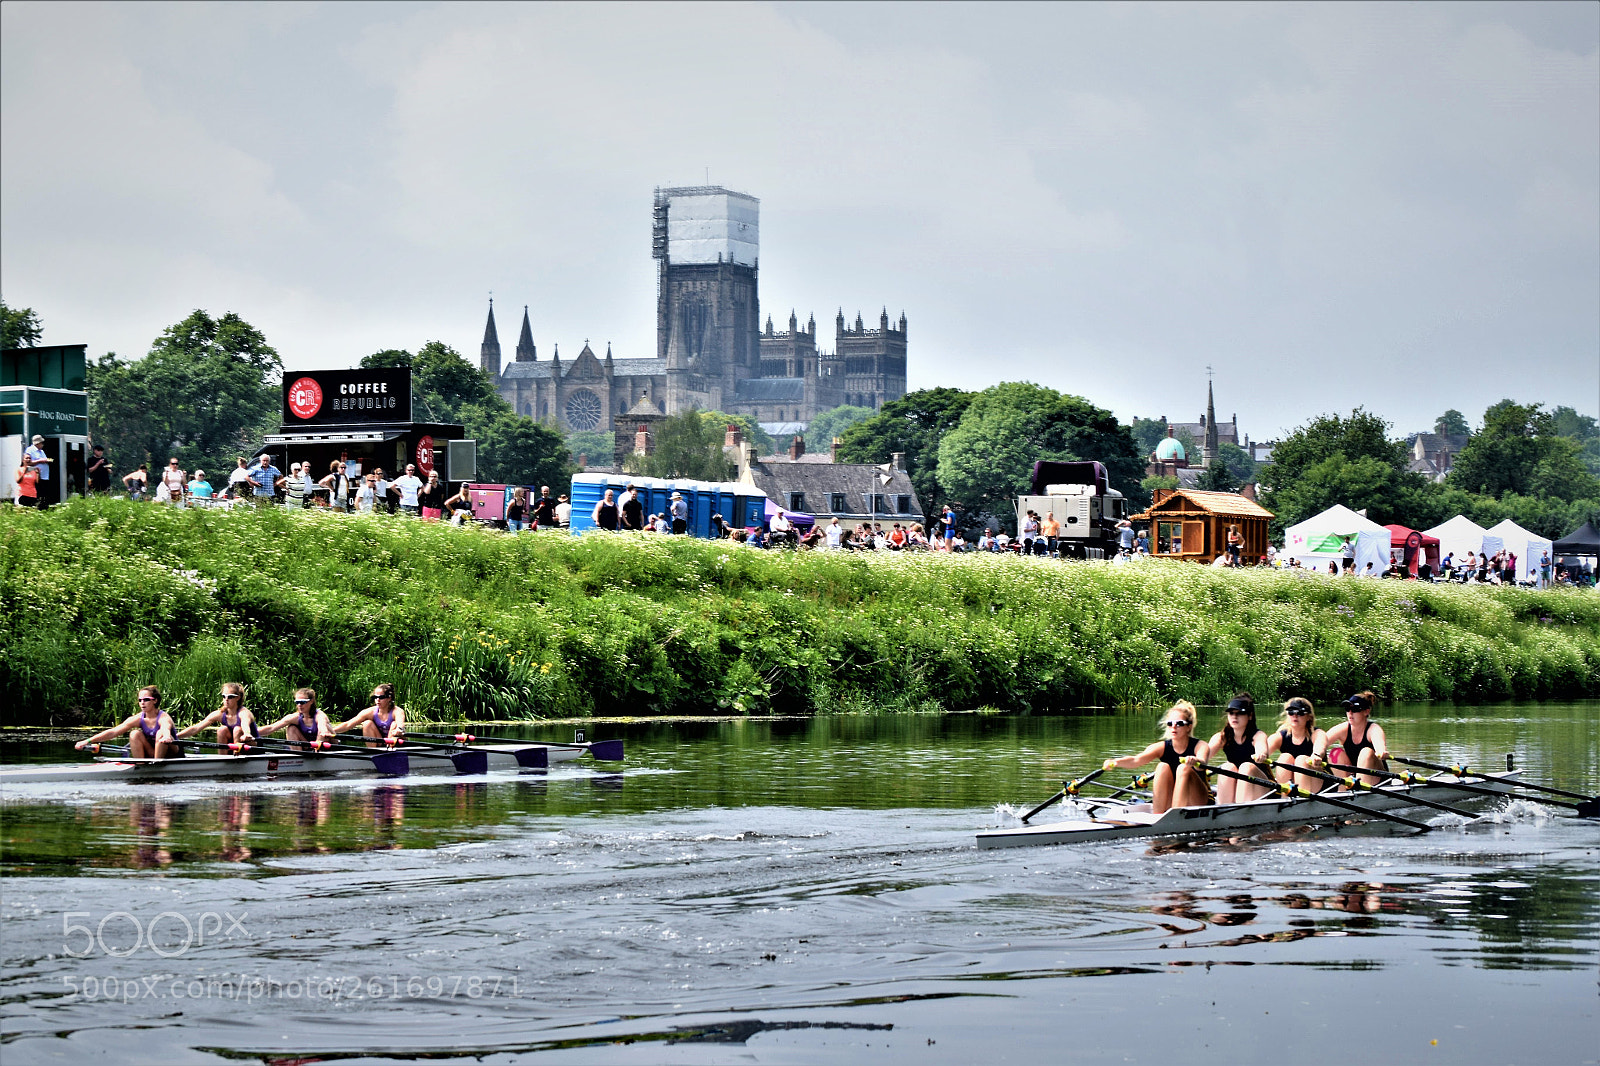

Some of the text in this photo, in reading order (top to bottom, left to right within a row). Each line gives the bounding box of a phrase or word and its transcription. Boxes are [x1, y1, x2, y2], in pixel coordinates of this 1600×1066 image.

[340, 382, 388, 395] COFFEE
[332, 396, 396, 410] REPUBLIC
[39, 410, 76, 421] HOG ROAST
